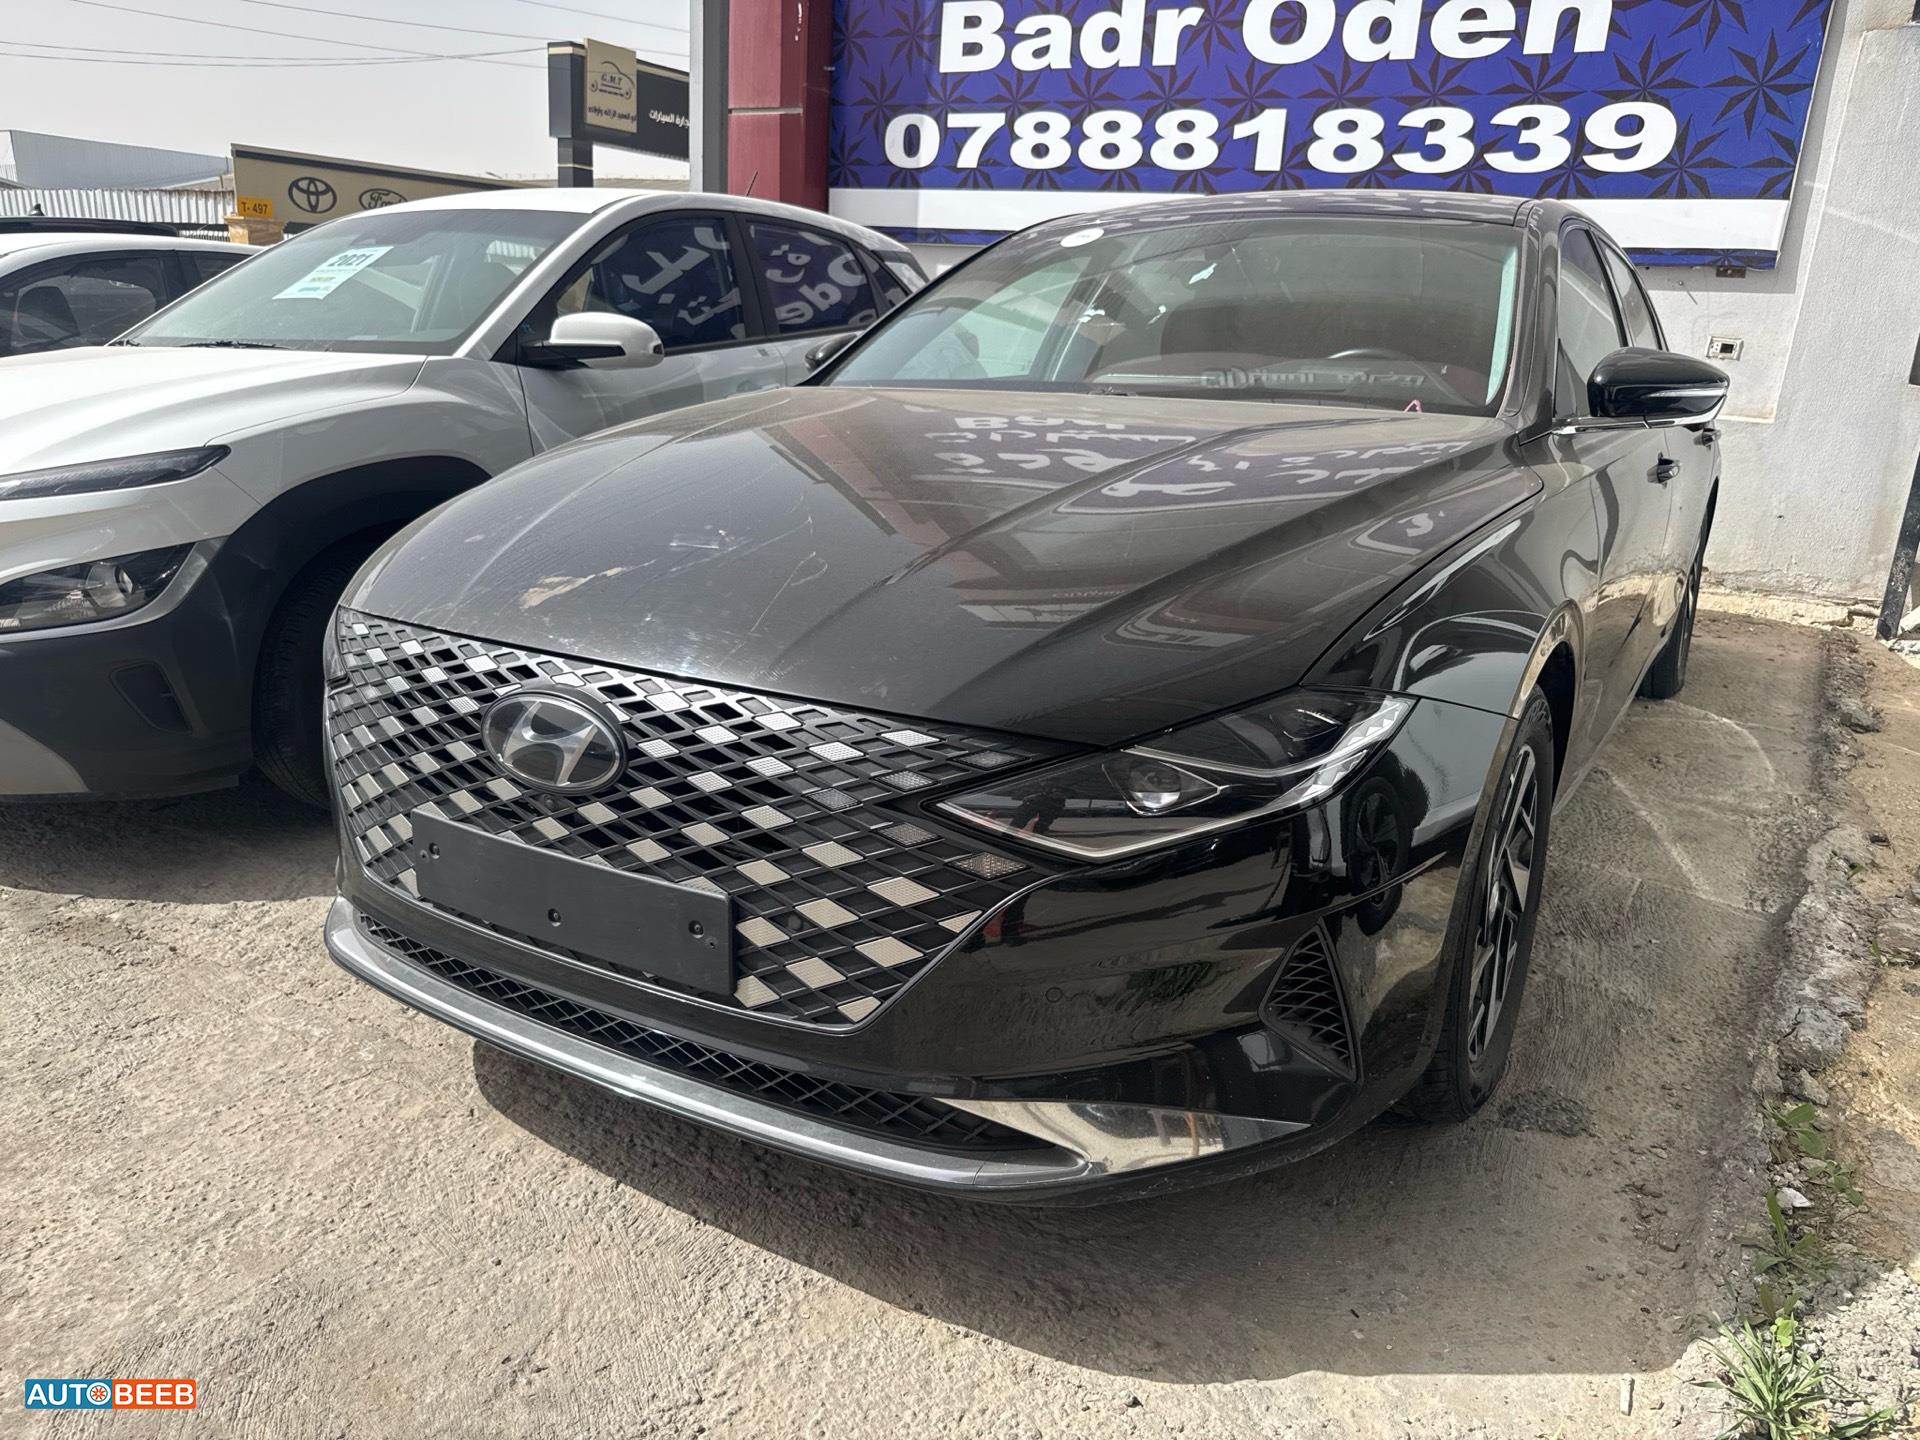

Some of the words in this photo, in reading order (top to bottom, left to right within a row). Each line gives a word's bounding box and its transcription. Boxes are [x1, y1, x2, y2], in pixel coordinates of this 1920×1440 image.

[939, 0, 1205, 73] Badr
[1242, 0, 1613, 65] Oden
[884, 101, 1678, 174] 0788818339
[252, 203, 268, 215] 497
[327, 253, 374, 267] 2021
